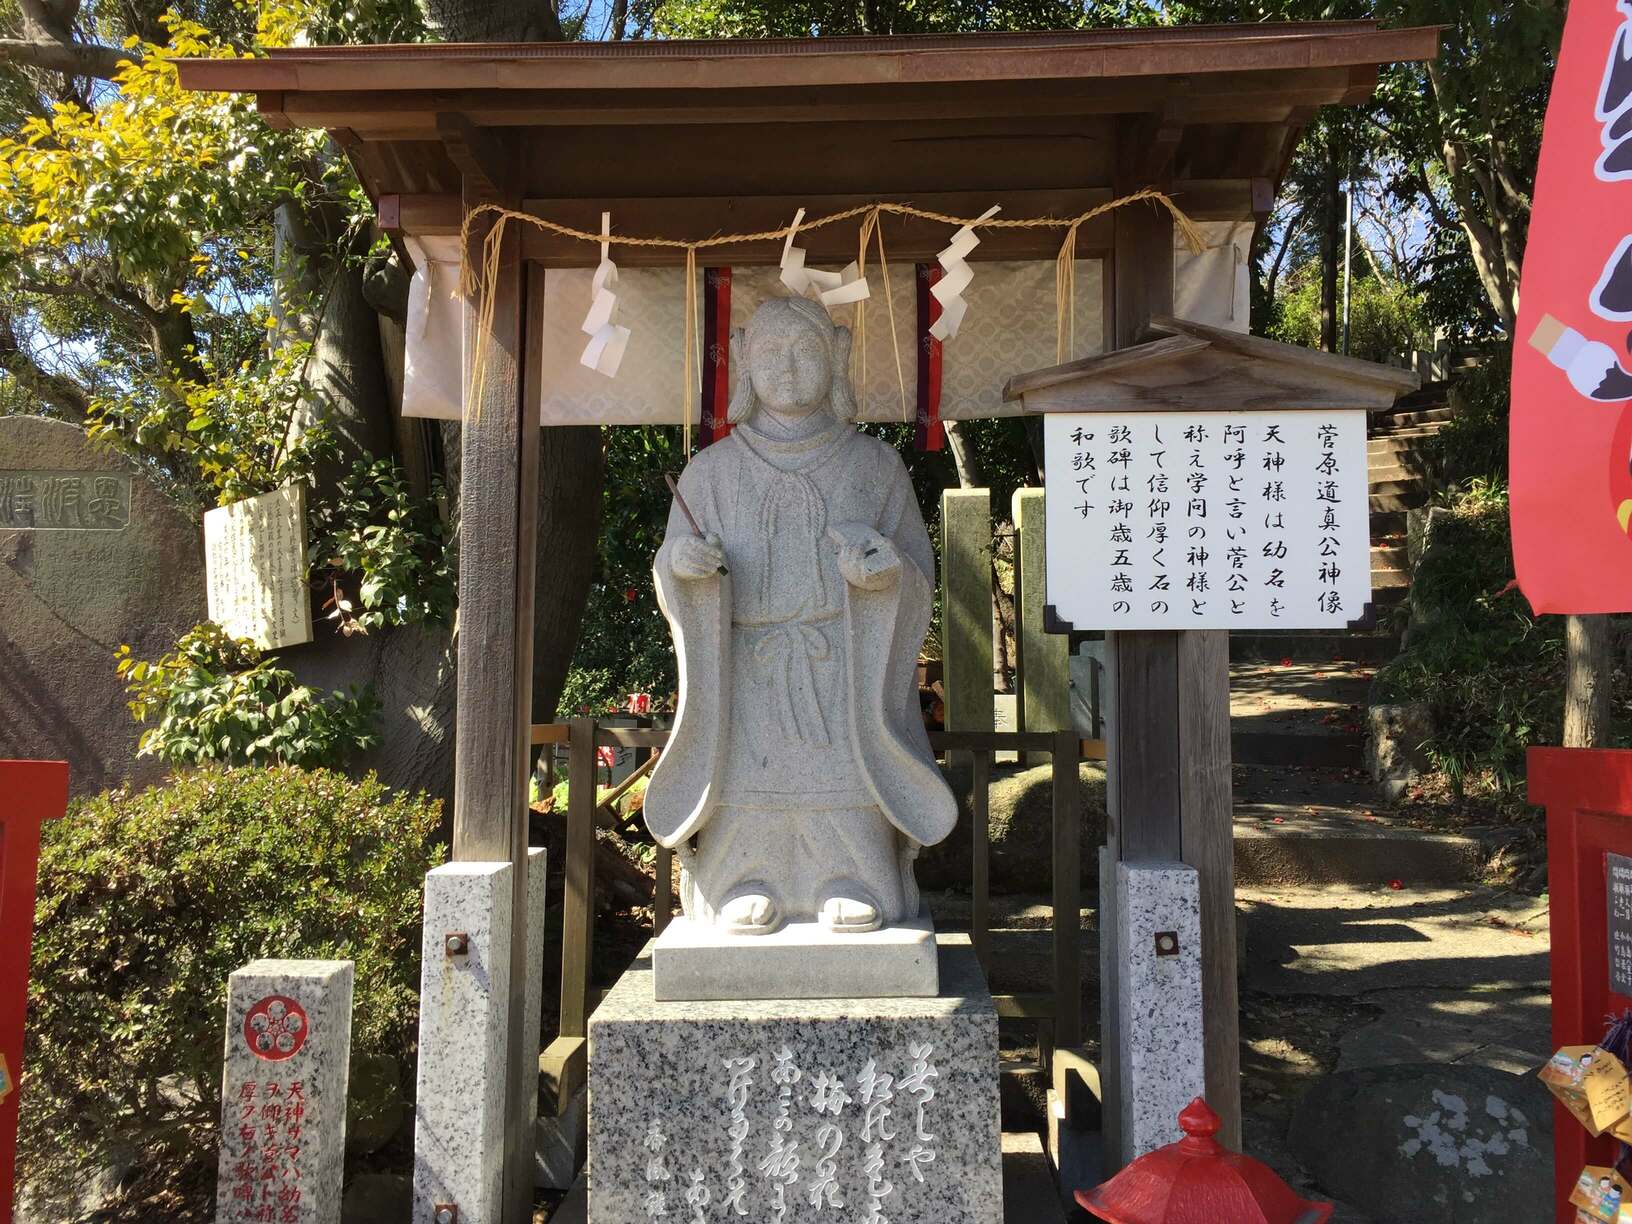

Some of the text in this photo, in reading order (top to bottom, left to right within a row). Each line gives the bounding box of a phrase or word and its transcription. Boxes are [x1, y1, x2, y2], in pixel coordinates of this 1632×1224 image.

[1070, 426, 1096, 520] 和歌です
[1107, 425, 1133, 614] 歌碑は御歳五歳の
[1147, 424, 1170, 615] して信仰厚く石の
[1183, 424, 1209, 616] 称え学問の神様と
[1223, 424, 1248, 615] 阿呼と言い菅公と
[1263, 424, 1287, 617] 天神様は幼名を
[1316, 424, 1343, 613] 菅原道真公神像
